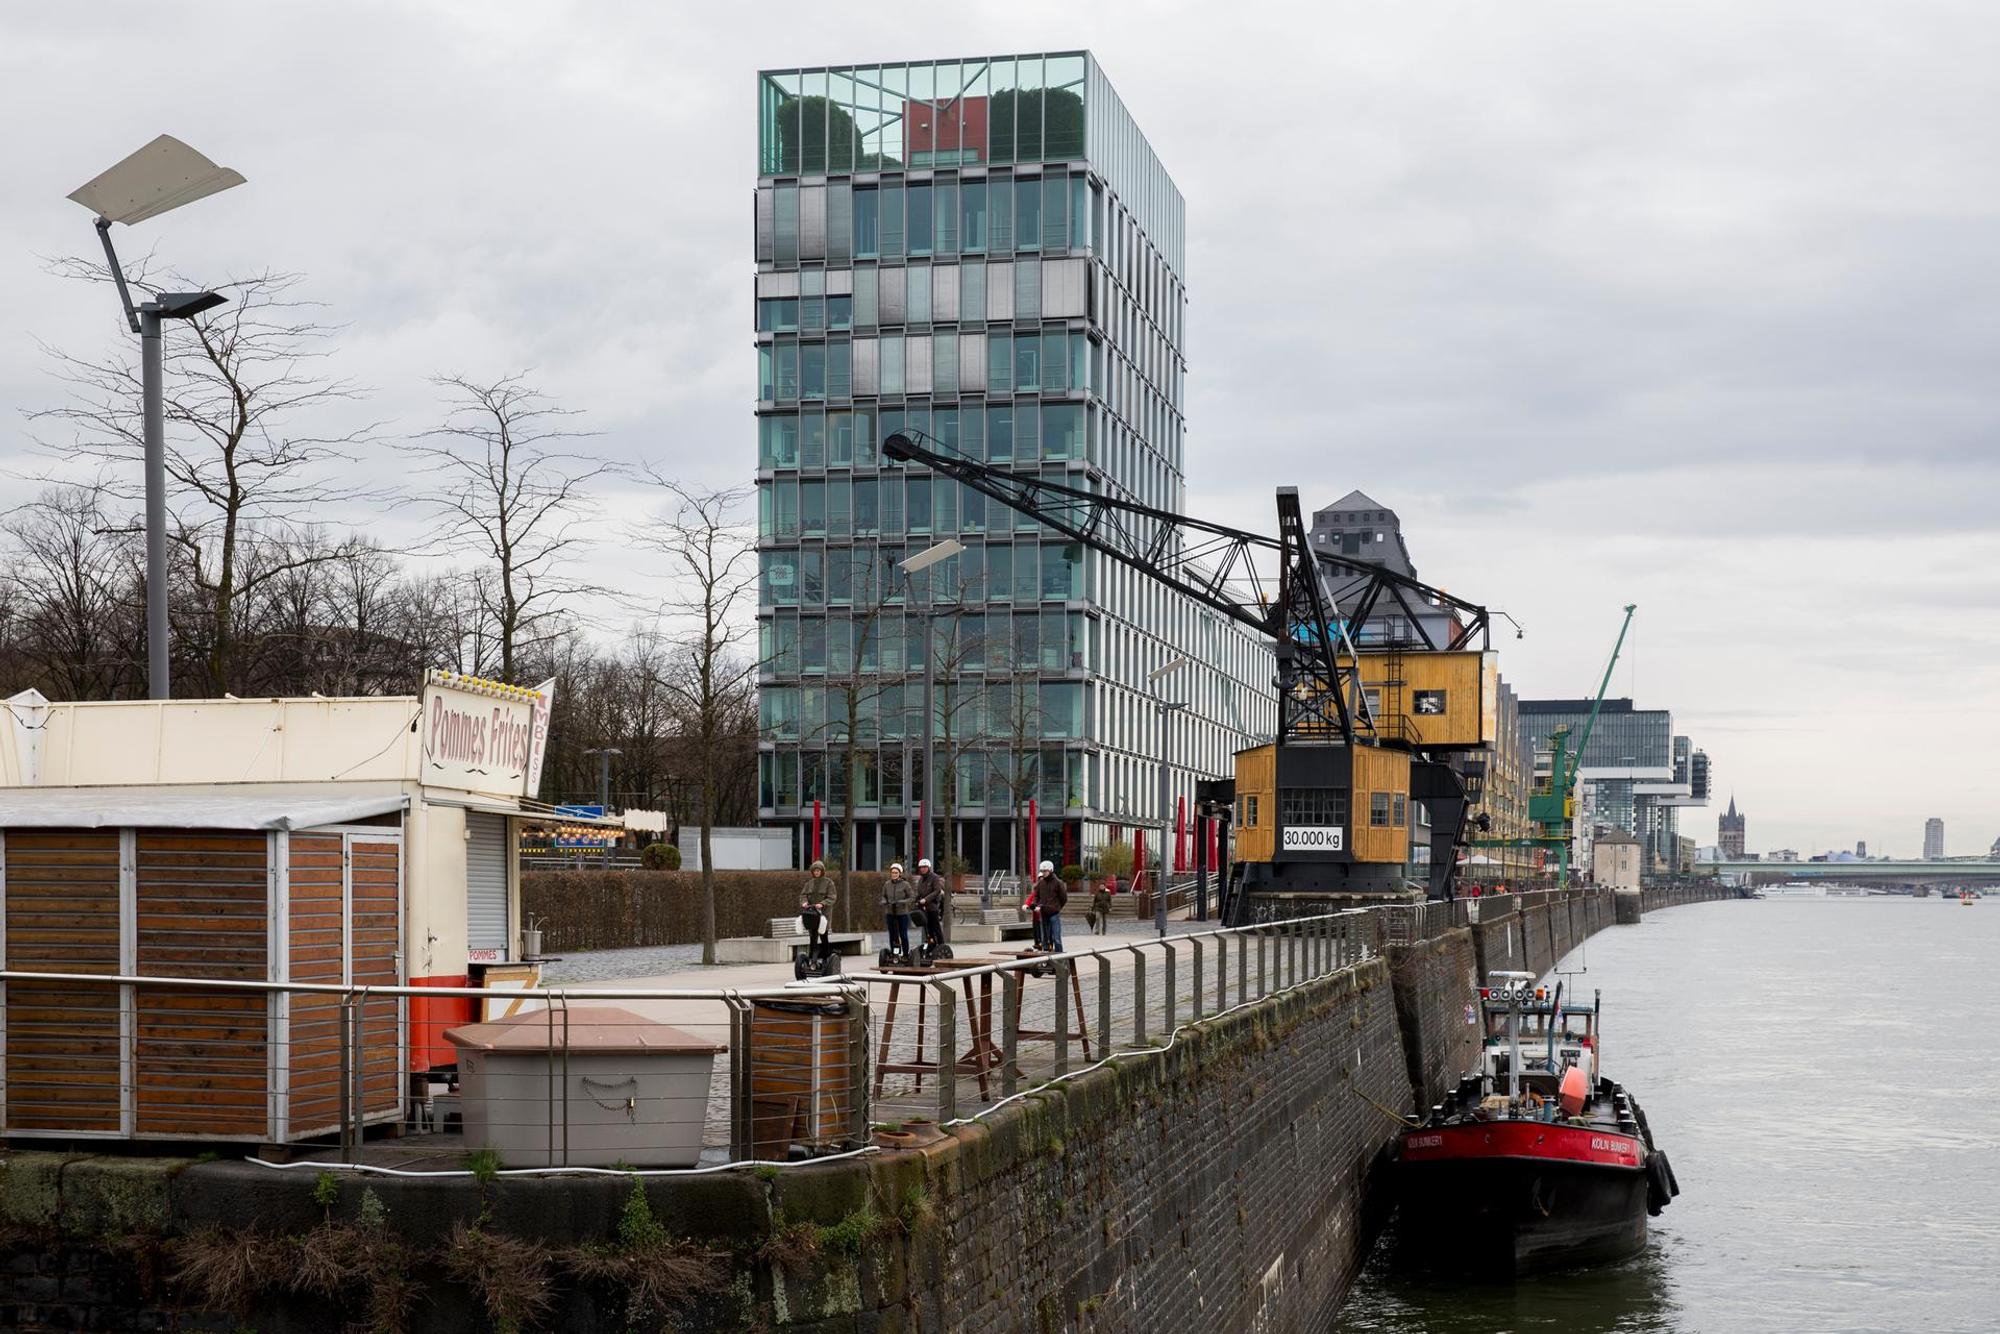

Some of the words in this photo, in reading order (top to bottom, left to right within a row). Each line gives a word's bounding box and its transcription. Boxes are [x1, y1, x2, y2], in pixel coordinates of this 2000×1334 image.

[430, 695, 487, 765] Pommes
[489, 707, 528, 770] Frites
[531, 693, 549, 783] IMBISS
[1284, 830, 1324, 846] 30.000
[1326, 831, 1340, 848] kg
[469, 949, 497, 960] POMMES
[1591, 1136, 1609, 1150] KÖLN
